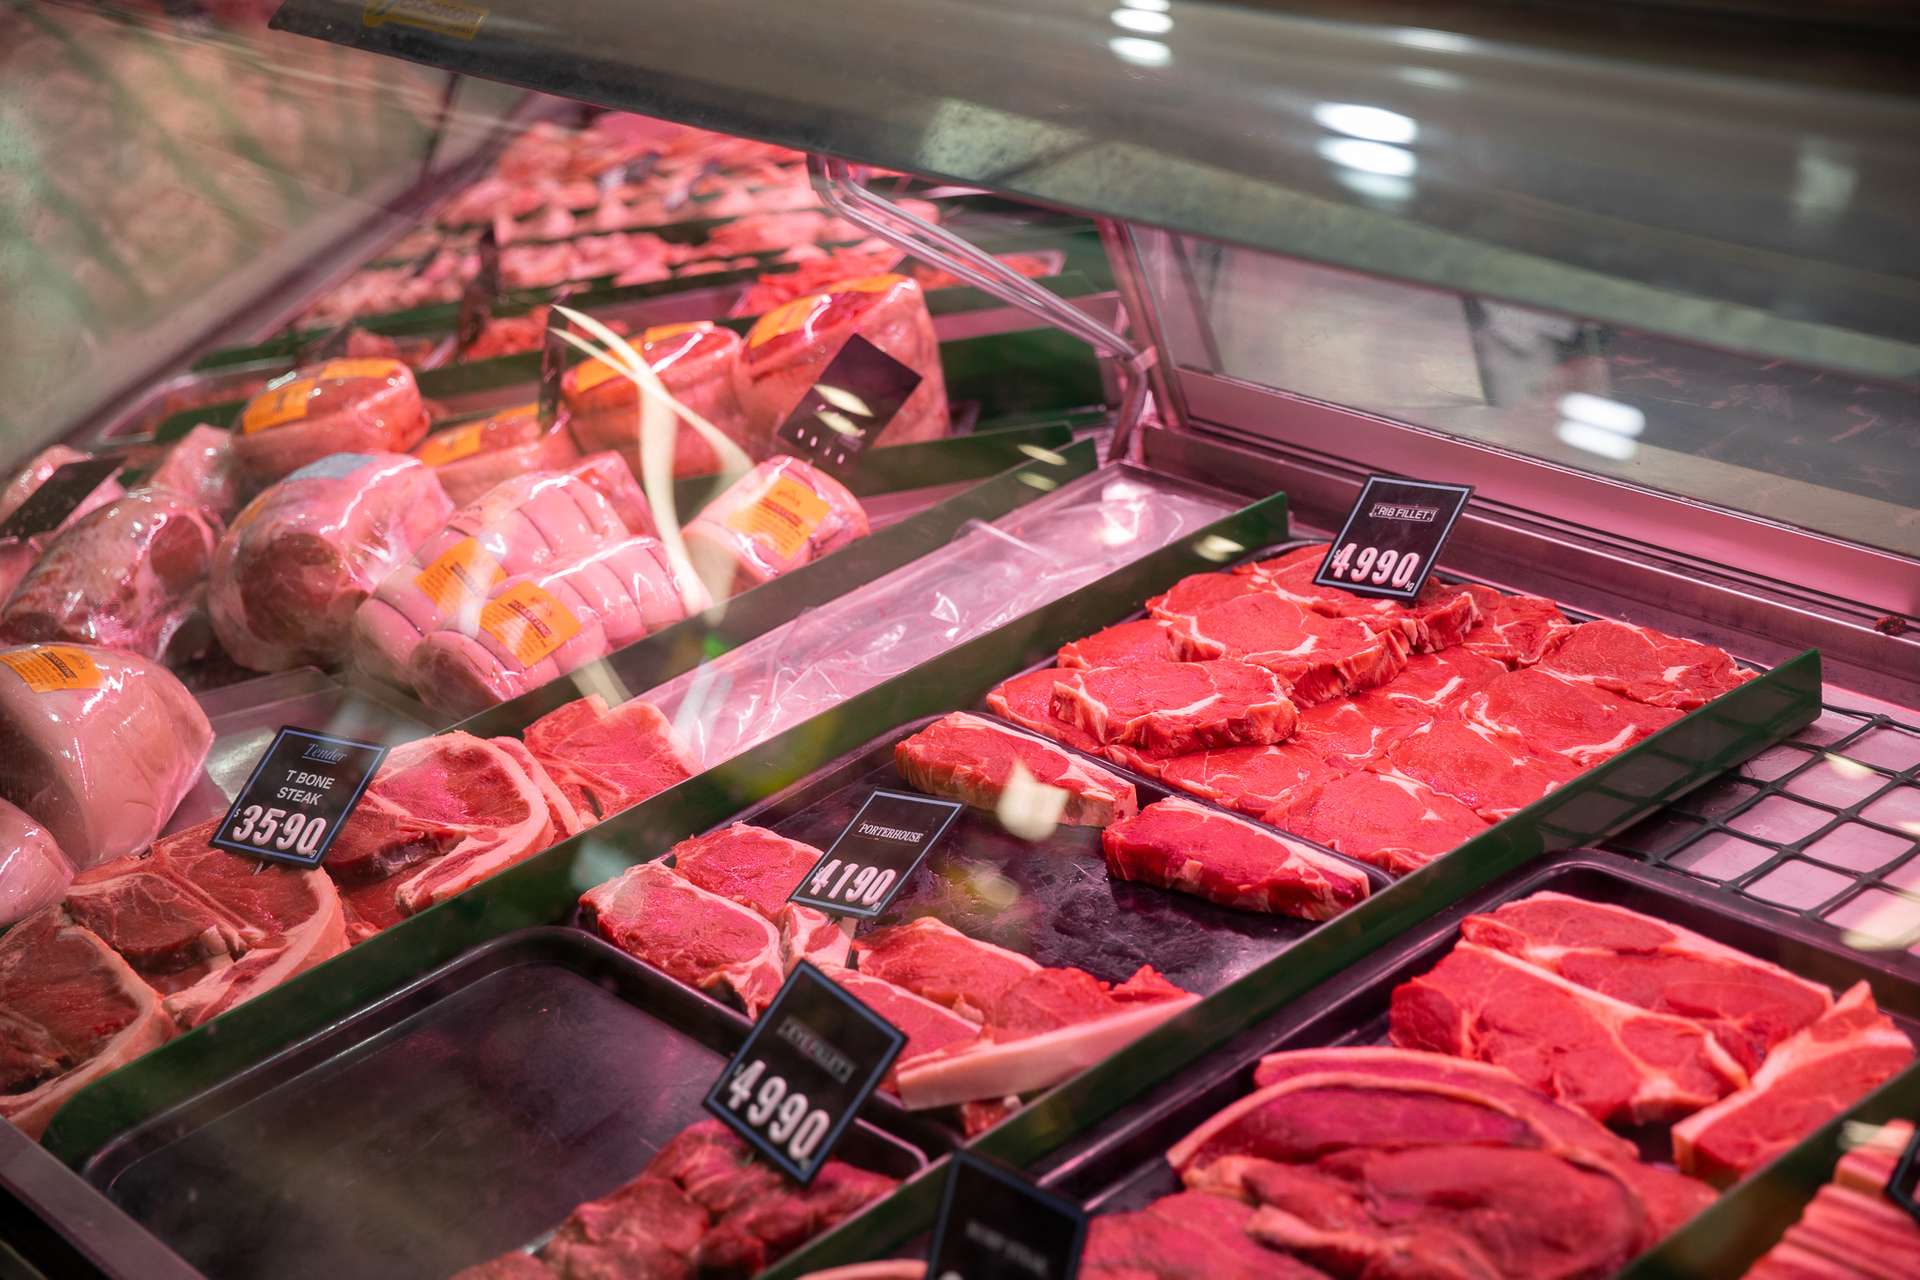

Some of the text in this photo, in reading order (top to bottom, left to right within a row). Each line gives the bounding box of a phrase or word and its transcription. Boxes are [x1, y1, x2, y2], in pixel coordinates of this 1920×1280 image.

[1378, 506, 1430, 520] RIB FILLET
[303, 743, 348, 763] Tender
[286, 769, 335, 790] T BONE
[276, 787, 323, 806] STEAK
[858, 823, 924, 843] PORTERHOUSE
